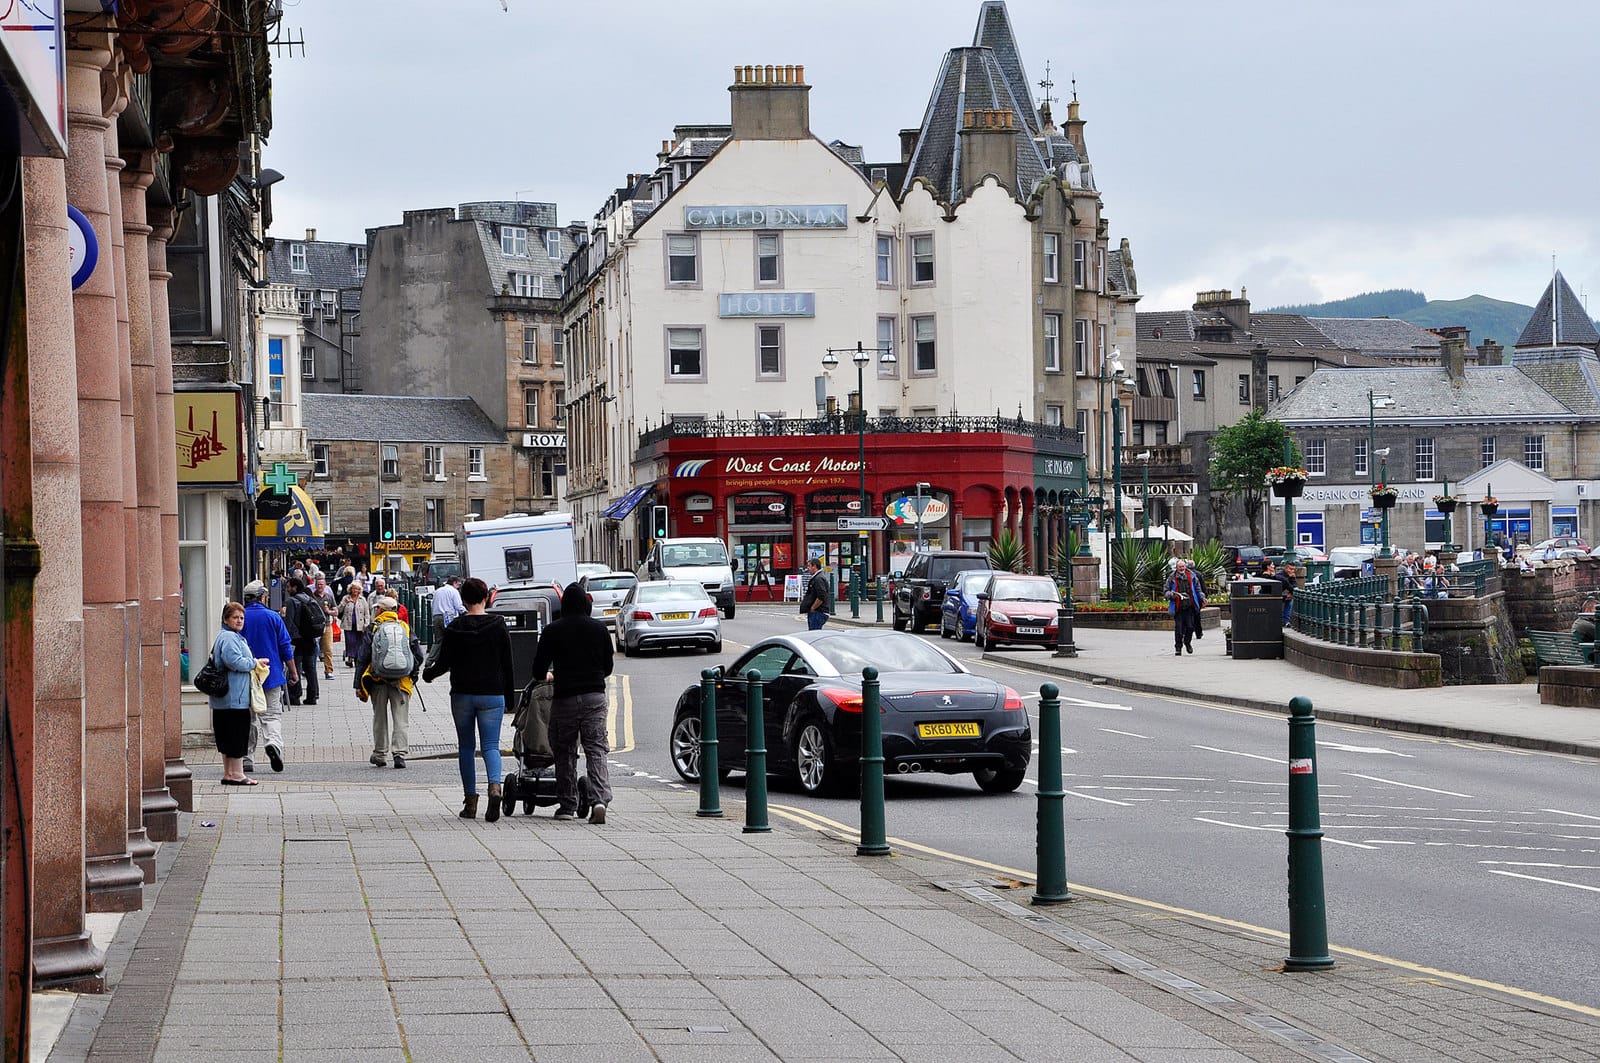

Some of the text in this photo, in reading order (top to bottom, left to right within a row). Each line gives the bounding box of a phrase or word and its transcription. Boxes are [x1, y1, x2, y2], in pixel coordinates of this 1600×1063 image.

[727, 297, 807, 313] HOTEL
[725, 456, 866, 473] West Coast Motors
[725, 479, 753, 487] bringing
[754, 479, 776, 487] people
[777, 478, 805, 486] together
[1317, 490, 1347, 501] BANK
[1349, 489, 1365, 500] OF
[927, 504, 946, 512] Mull
[416, 540, 431, 550] shop
[1366, 563, 1372, 571] P
[924, 724, 975, 735] SK60 XKH
